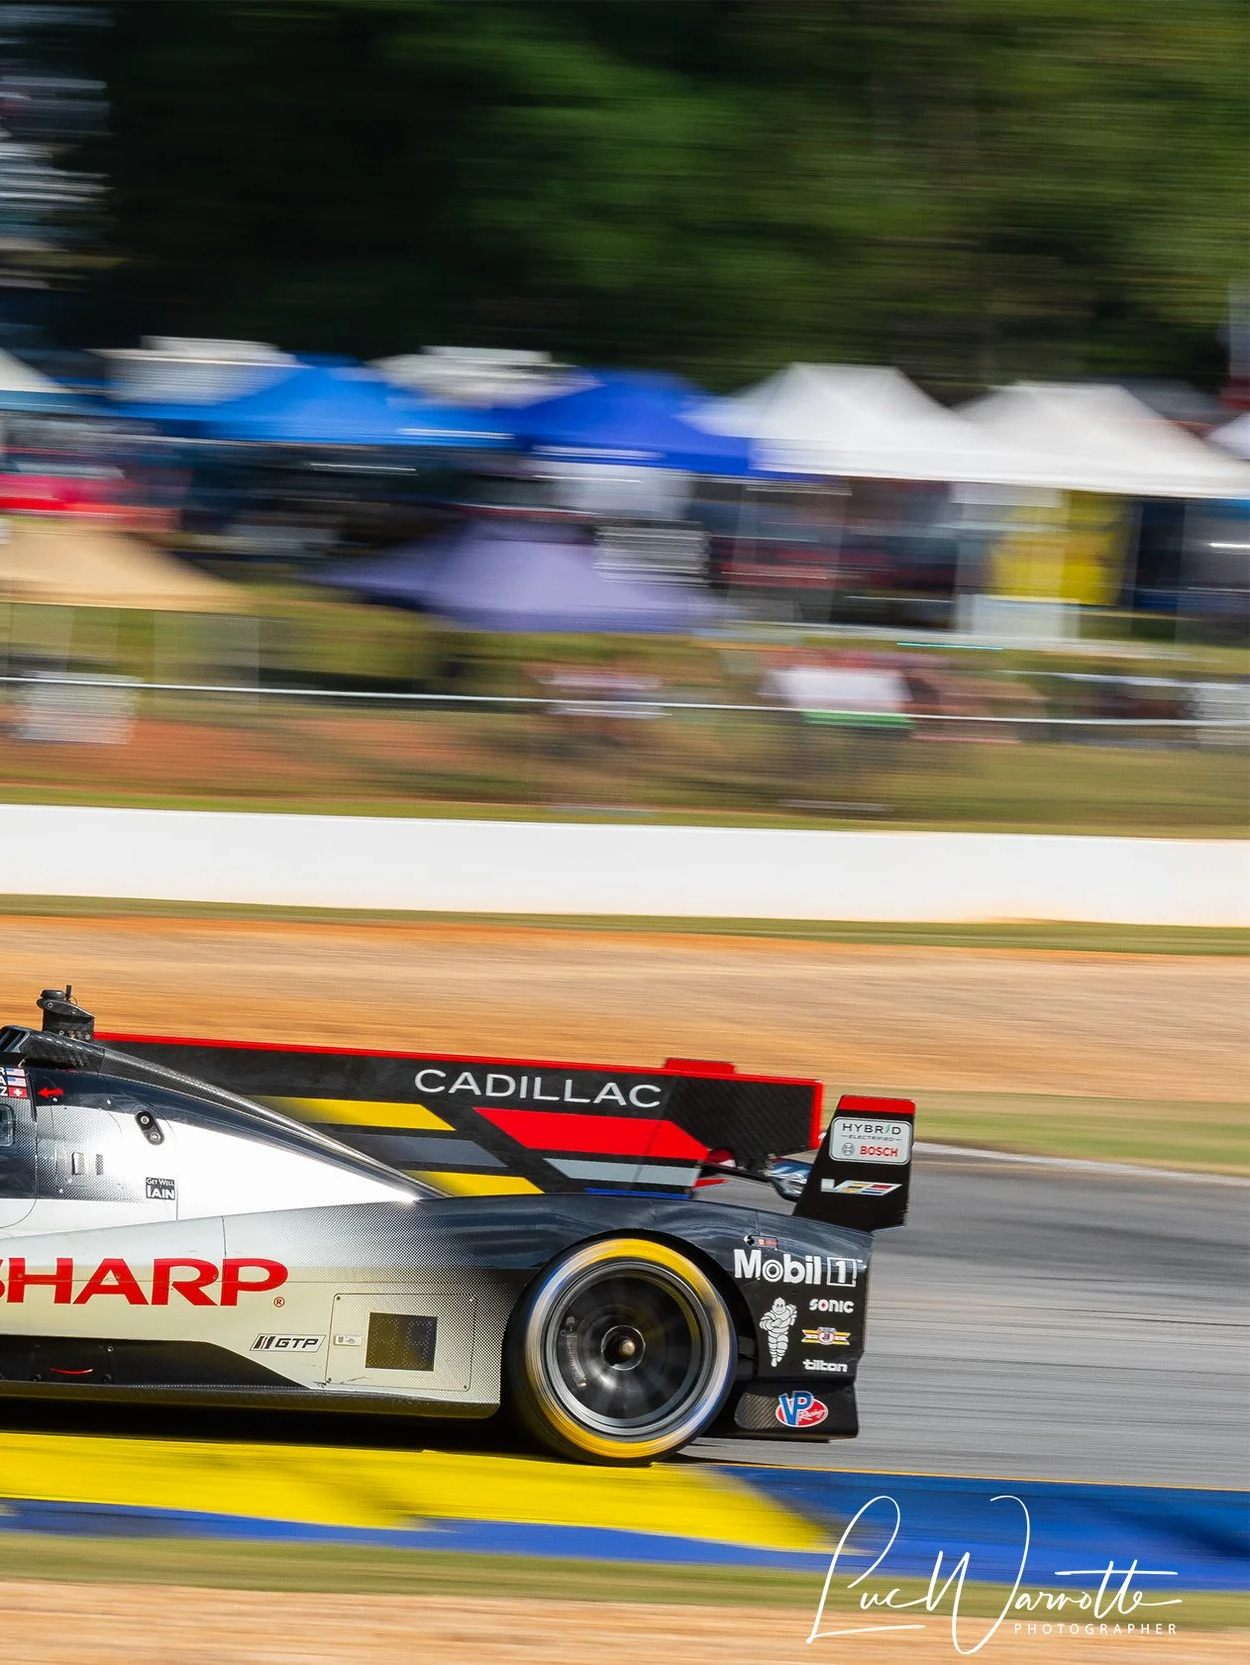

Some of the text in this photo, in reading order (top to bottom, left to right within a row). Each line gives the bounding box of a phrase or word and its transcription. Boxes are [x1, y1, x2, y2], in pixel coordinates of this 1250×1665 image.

[414, 1069, 662, 1108] CADILLAC
[842, 1123, 902, 1135] HYBRID
[859, 1145, 899, 1157] BOSCH
[733, 1249, 822, 1285] Mobil
[275, 1337, 319, 1349] GTP
[802, 1359, 848, 1373] tilton
[778, 1391, 815, 1426] VP
